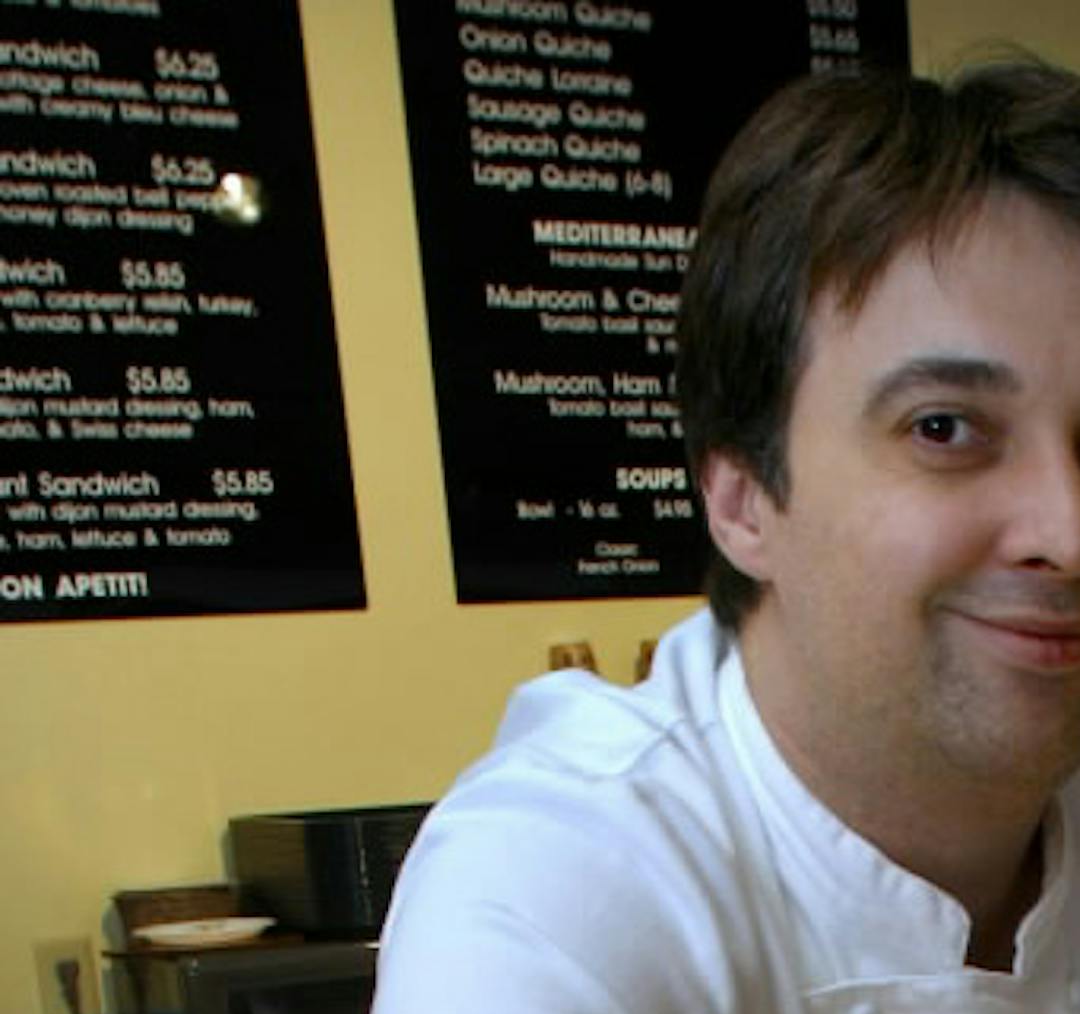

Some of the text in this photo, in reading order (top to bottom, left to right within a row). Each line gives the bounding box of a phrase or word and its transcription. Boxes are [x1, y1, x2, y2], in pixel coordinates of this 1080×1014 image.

[458, 23, 527, 52] Onion
[533, 29, 612, 62] Quiche
[154, 47, 219, 80] $6.25
[463, 58, 633, 97] Quiche Lorraine
[467, 92, 646, 132] Sausage Quiche
[470, 126, 642, 163] Spinach Quiche
[151, 154, 215, 185] $6.25
[473, 160, 534, 192] Large
[540, 163, 618, 193] Quiche
[121, 259, 186, 290] $5.85
[486, 283, 595, 310] Mushroom
[602, 287, 620, 311] &
[12, 312, 82, 333] tomato
[126, 366, 191, 394] $5.85
[37, 471, 160, 497] Sandwich
[211, 468, 274, 497] $5.85
[616, 467, 687, 489] SOUPS
[71, 527, 137, 549] lettuce
[166, 526, 231, 546] tomato
